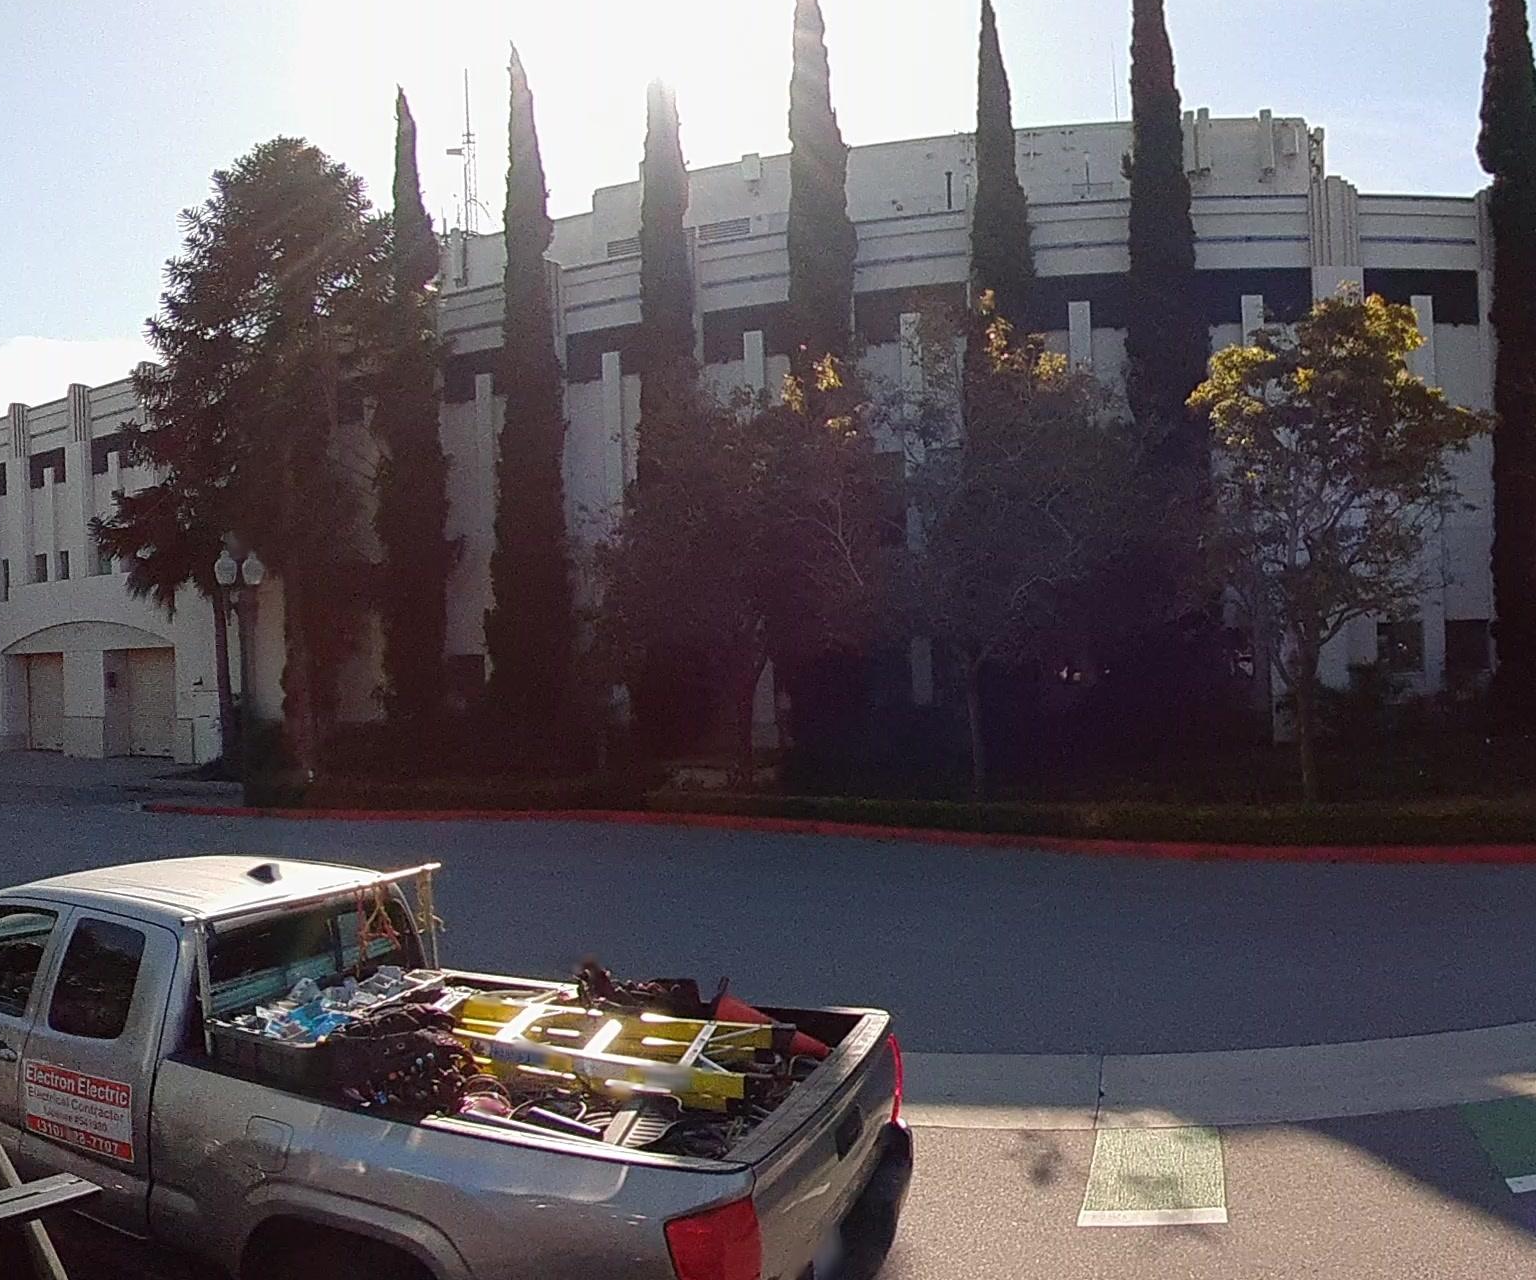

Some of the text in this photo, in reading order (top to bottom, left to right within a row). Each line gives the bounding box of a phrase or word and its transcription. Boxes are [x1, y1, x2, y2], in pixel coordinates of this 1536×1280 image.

[26, 1064, 128, 1105] Electron Electric
[71, 1098, 124, 1121] Contractor
